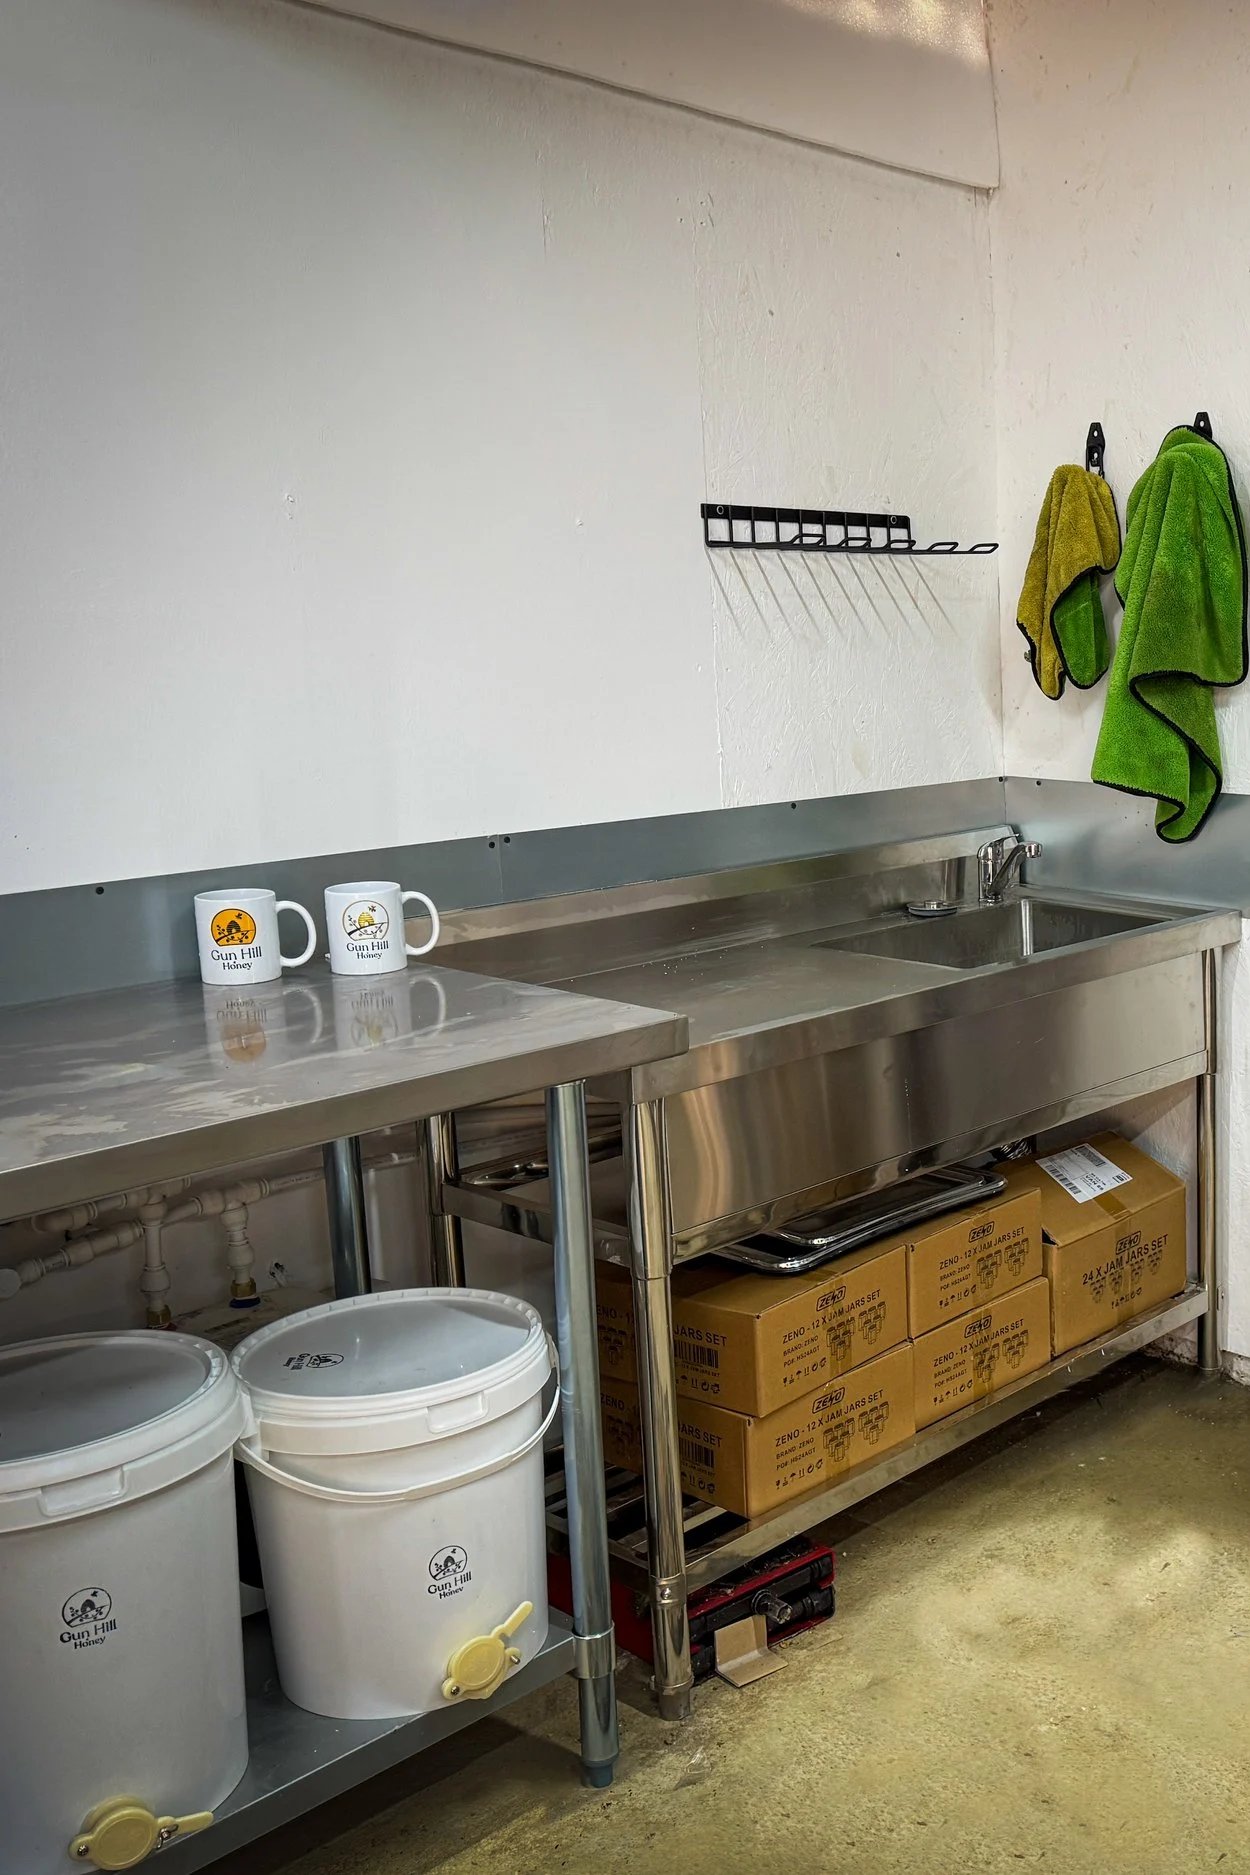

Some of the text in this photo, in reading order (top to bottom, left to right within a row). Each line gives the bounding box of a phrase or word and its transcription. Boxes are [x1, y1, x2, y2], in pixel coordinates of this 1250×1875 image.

[211, 946, 262, 961] Gun Hill
[346, 940, 389, 952] Gun Hill
[357, 951, 383, 960] Honey
[222, 961, 253, 971] Honey
[939, 1255, 959, 1271] ZENO
[964, 1249, 972, 1260] 12
[978, 1240, 994, 1253] JAM
[993, 1231, 1011, 1247] JARS
[1012, 1226, 1025, 1239] SET
[1082, 1233, 1168, 1286] 24 X JAM JARS SET
[597, 1304, 618, 1319] ENO
[782, 1326, 806, 1344] ZENO
[811, 1319, 820, 1330] 12
[828, 1307, 845, 1322] JAM
[845, 1297, 866, 1314] JARS
[866, 1288, 881, 1303] SET
[674, 1324, 727, 1347] JARS SET
[933, 1351, 954, 1367] ZENO
[959, 1344, 968, 1355] 12
[974, 1335, 991, 1348] JAM
[990, 1326, 1009, 1340] JARS
[1010, 1318, 1024, 1331] SET
[775, 1428, 800, 1447] ZENO
[806, 1421, 816, 1432] 12
[824, 1408, 843, 1423] JAM
[843, 1397, 866, 1415] JARS
[867, 1389, 884, 1403] SET
[679, 1423, 722, 1447] ARS SET
[427, 1571, 472, 1594] Gun Hill
[60, 1618, 117, 1643] Gun Hill
[74, 1636, 106, 1649] Honey
